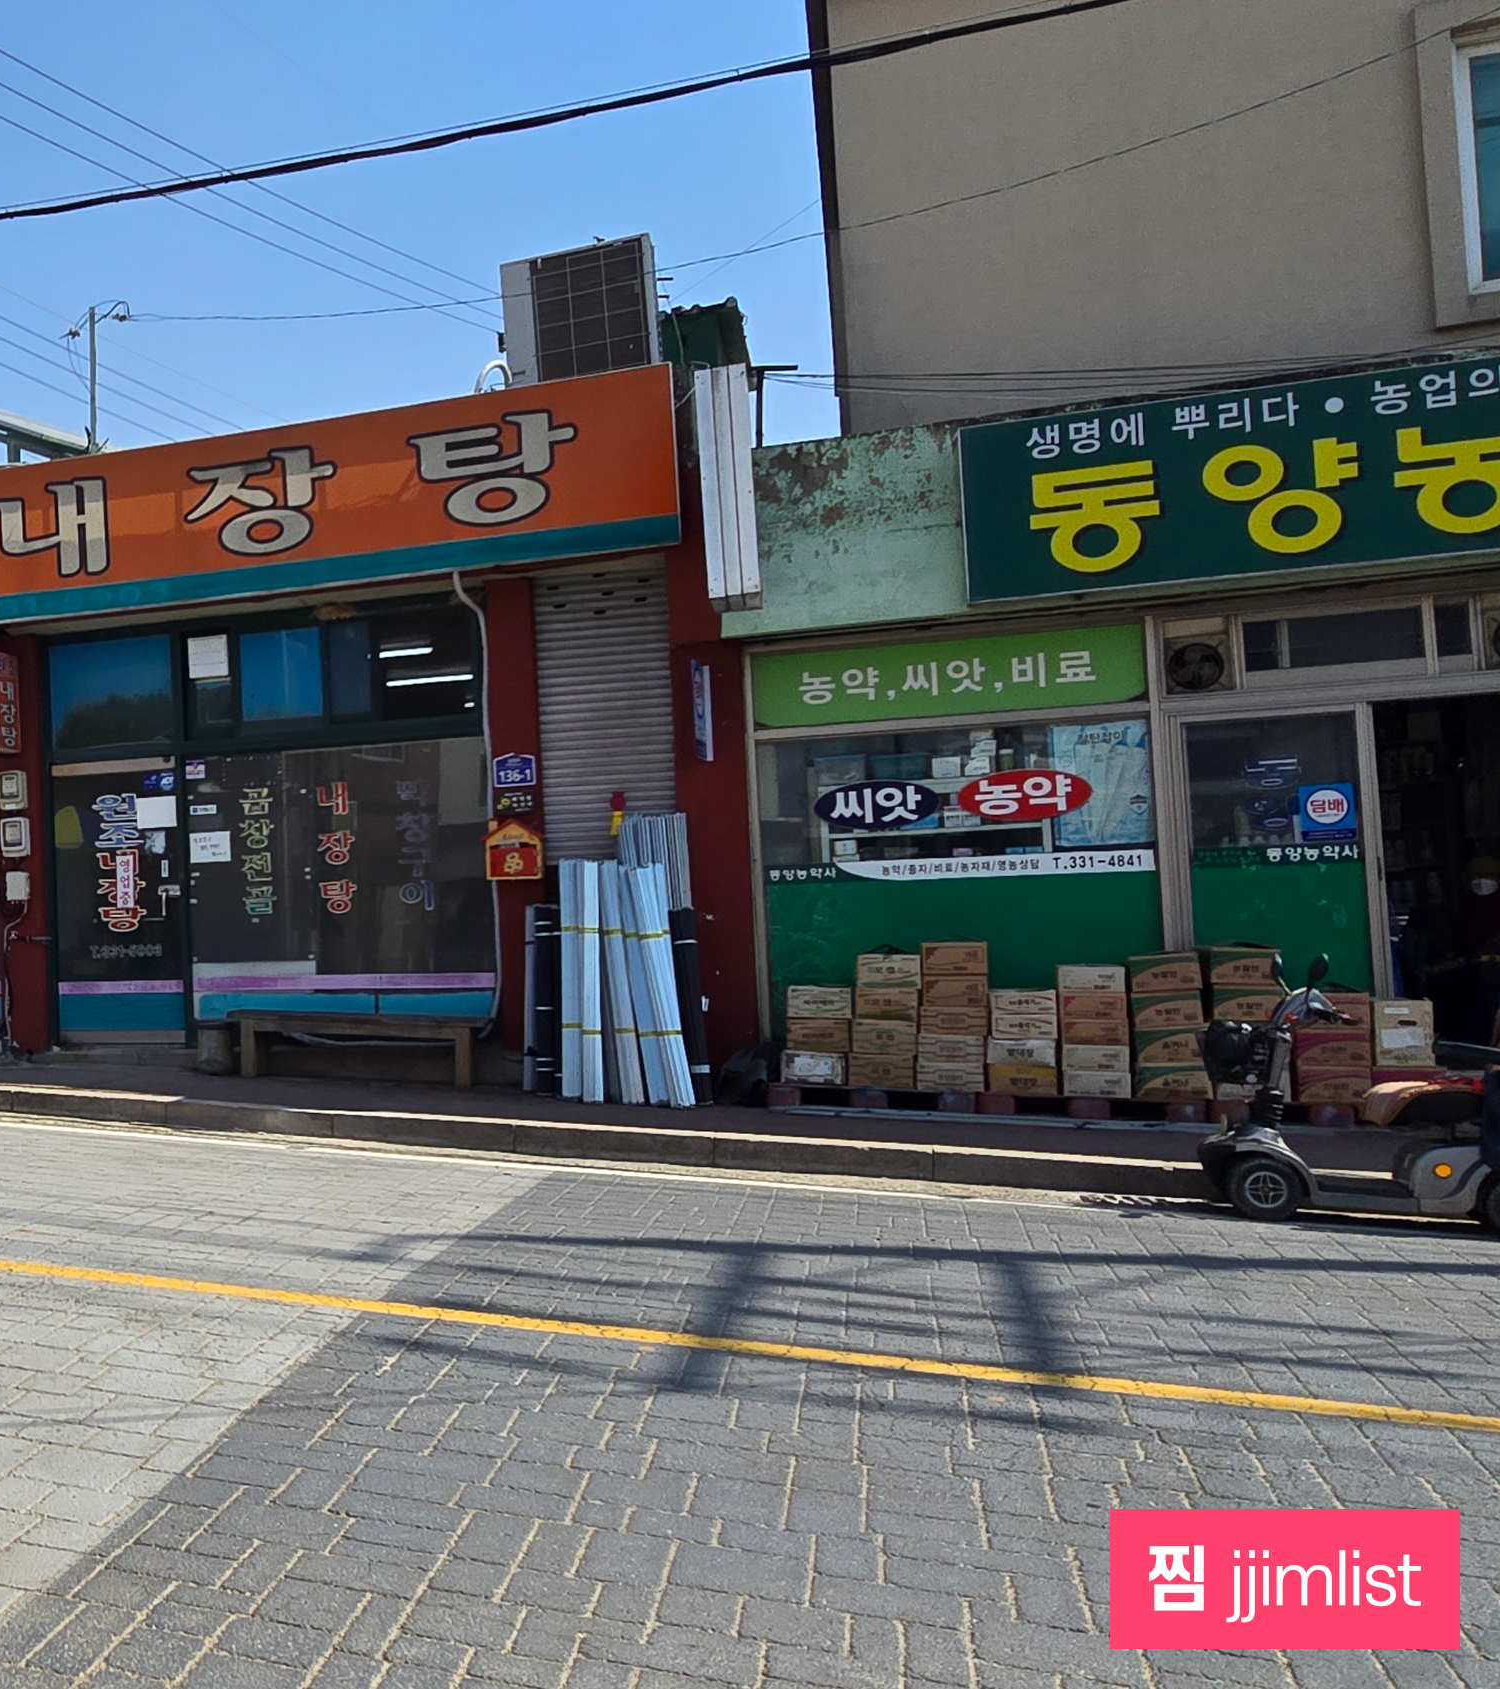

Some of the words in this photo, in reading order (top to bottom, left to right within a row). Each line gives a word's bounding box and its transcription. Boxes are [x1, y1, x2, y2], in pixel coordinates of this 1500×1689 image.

[1025, 412, 1146, 460] 생명에
[1172, 391, 1300, 439] 뿌리다
[0, 680, 17, 747] 내장탕
[498, 768, 532, 783] 136-1
[974, 774, 1073, 816] 농약
[91, 792, 145, 850] 원조
[829, 785, 922, 824] 씨앗
[1309, 798, 1345, 814] 담배
[315, 781, 359, 915] 내장탕
[1052, 854, 1144, 871] T.331-4841
[1265, 844, 1360, 863] 동양농약사
[119, 858, 132, 906] 영업중
[769, 866, 838, 881] 동양농약사
